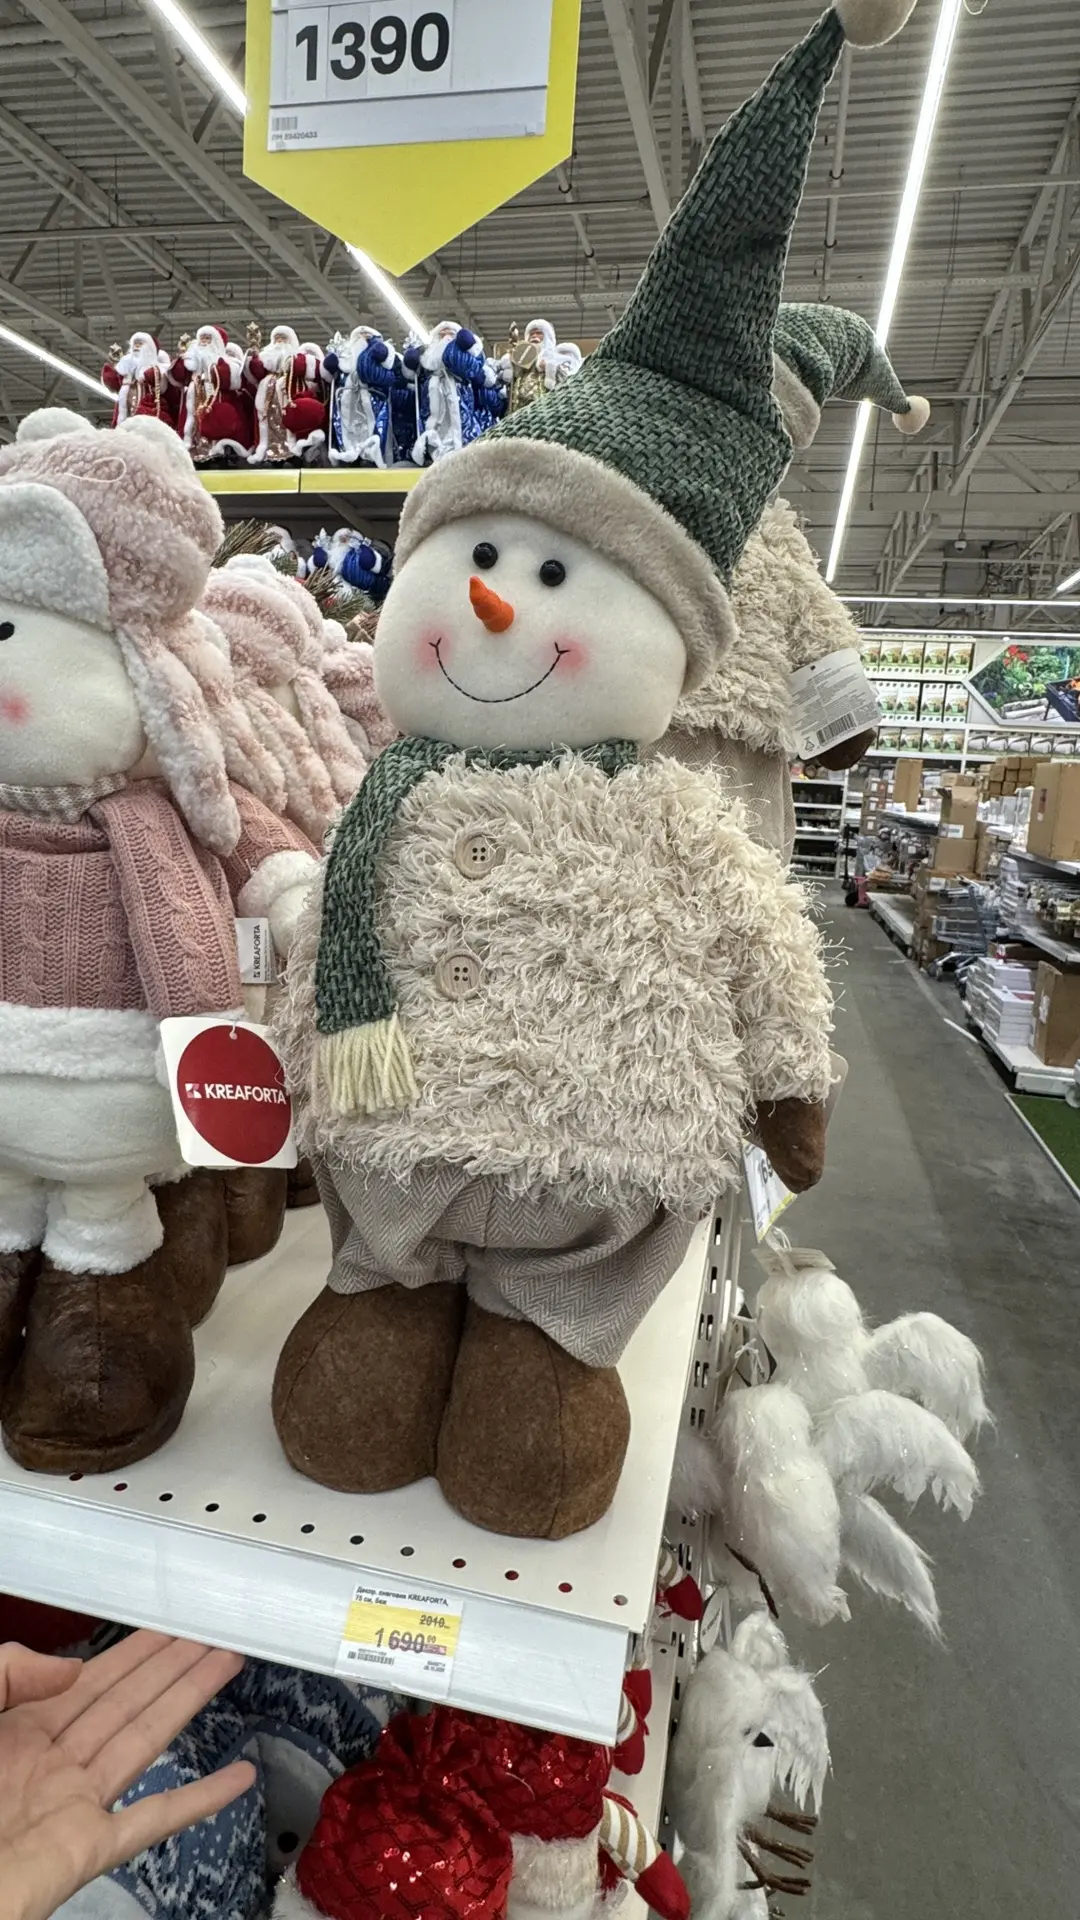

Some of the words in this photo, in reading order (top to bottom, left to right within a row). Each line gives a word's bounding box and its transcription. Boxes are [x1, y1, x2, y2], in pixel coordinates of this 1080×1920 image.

[295, 11, 450, 82] 1390
[253, 924, 261, 971] KREAFORTA
[204, 1083, 287, 1105] KREAFORTA
